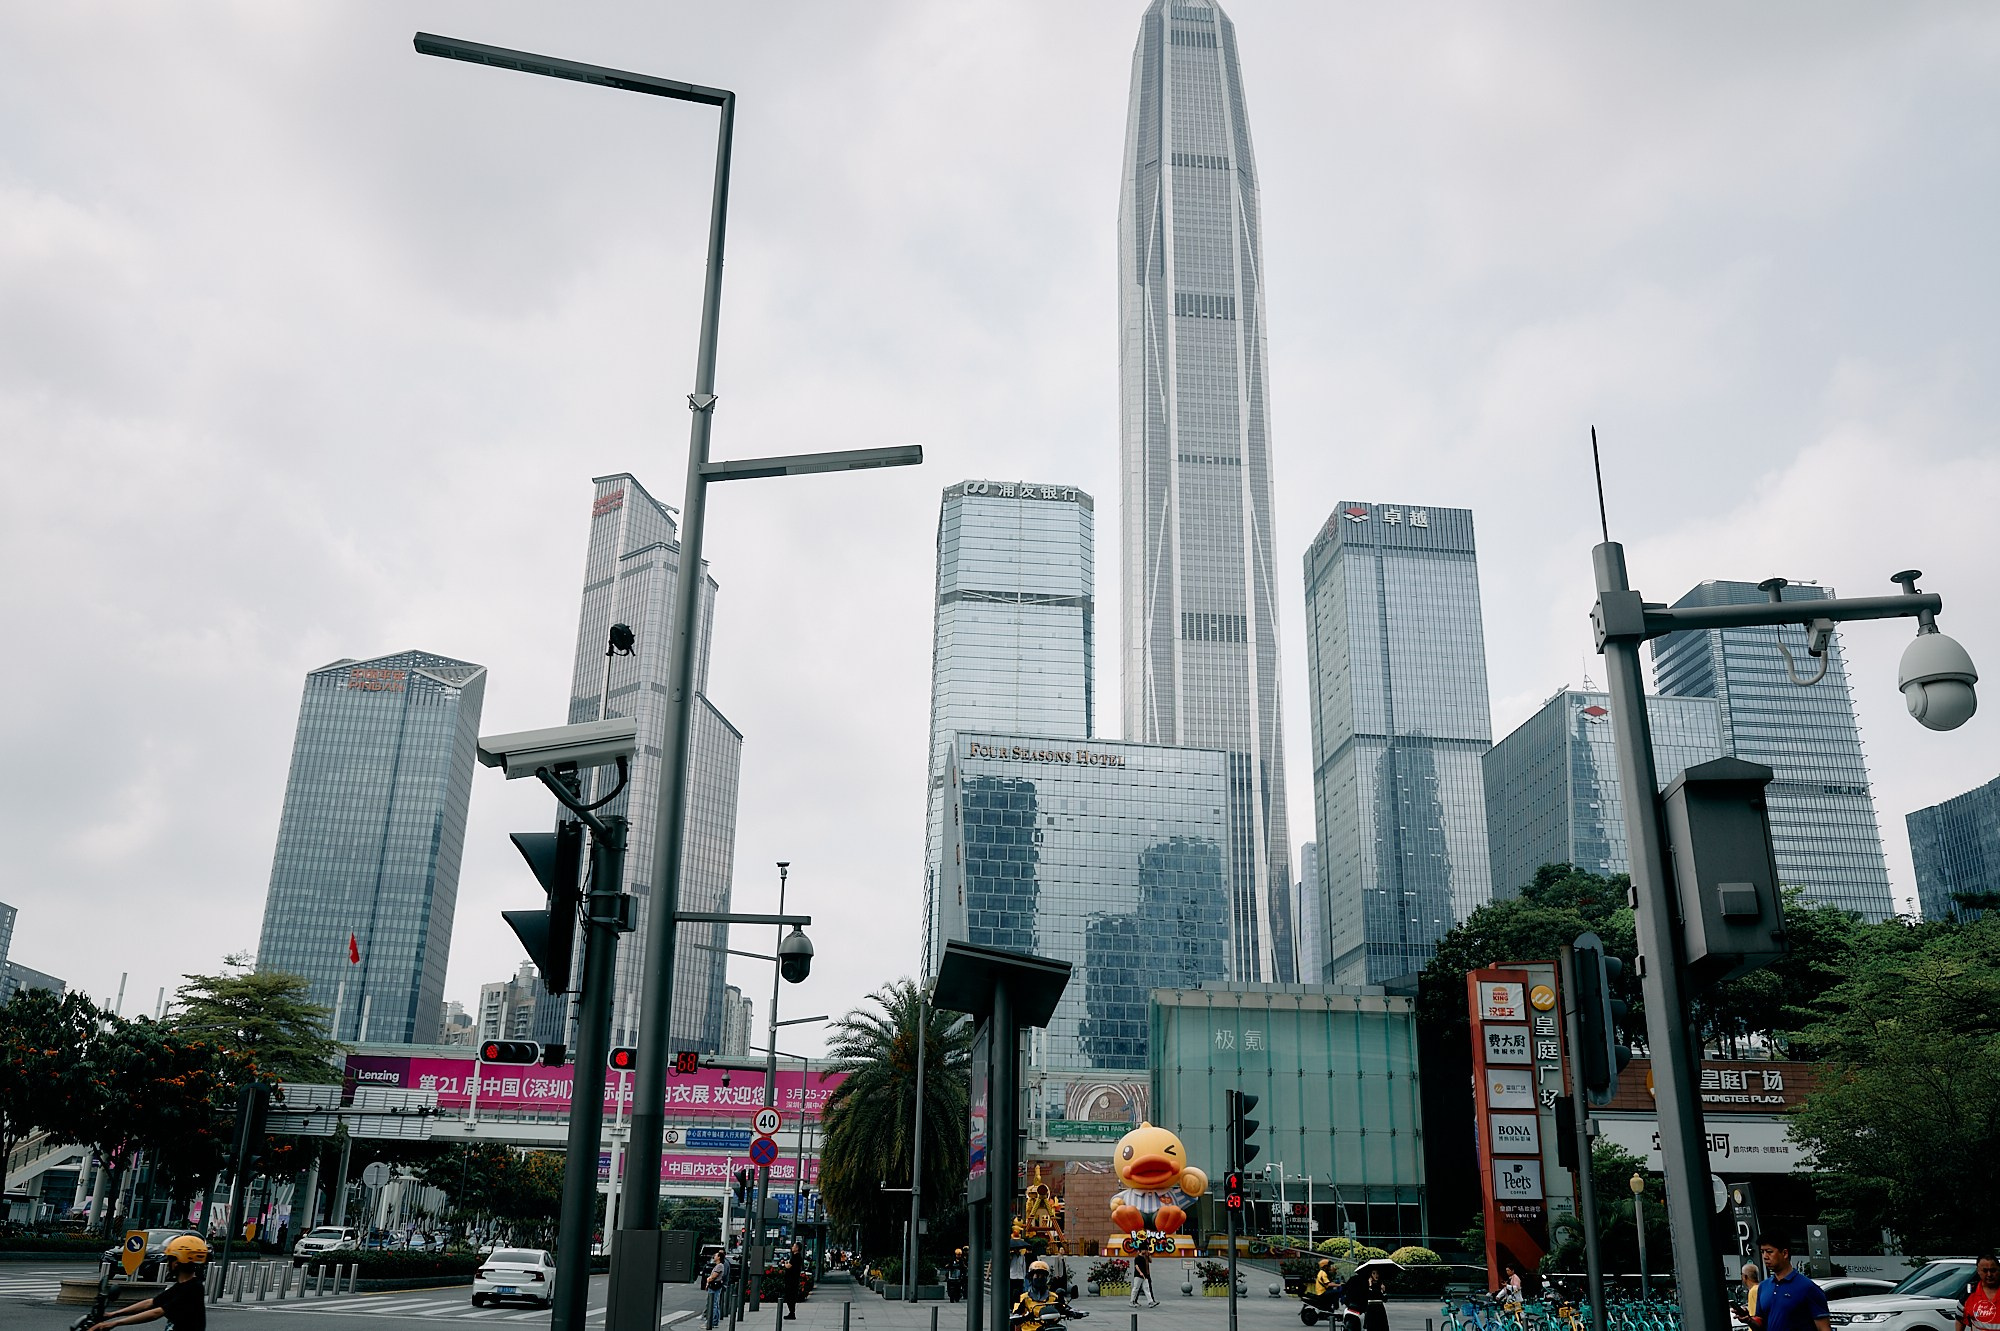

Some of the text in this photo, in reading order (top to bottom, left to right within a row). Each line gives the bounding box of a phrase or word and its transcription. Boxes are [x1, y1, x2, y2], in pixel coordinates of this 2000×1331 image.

[998, 483, 1079, 501] 浦发银行
[1382, 509, 1428, 528] 卓越
[970, 742, 1125, 767] FOUR SEASONS HOTEL
[1488, 1007, 1515, 1017] 汉堡王
[1215, 1028, 1265, 1051] 极氪
[1489, 1034, 1526, 1047] 费大厨
[677, 1053, 696, 1073] 68
[1535, 1016, 1560, 1109] 皇庭广场
[358, 1069, 400, 1083] Lenzing
[1700, 1069, 1784, 1091] 皇庭广场
[1701, 1094, 1785, 1104] WONGTEE PLAZA
[759, 1115, 776, 1129] 40
[1498, 1126, 1530, 1135] BONA
[1227, 1195, 1241, 1208] 28
